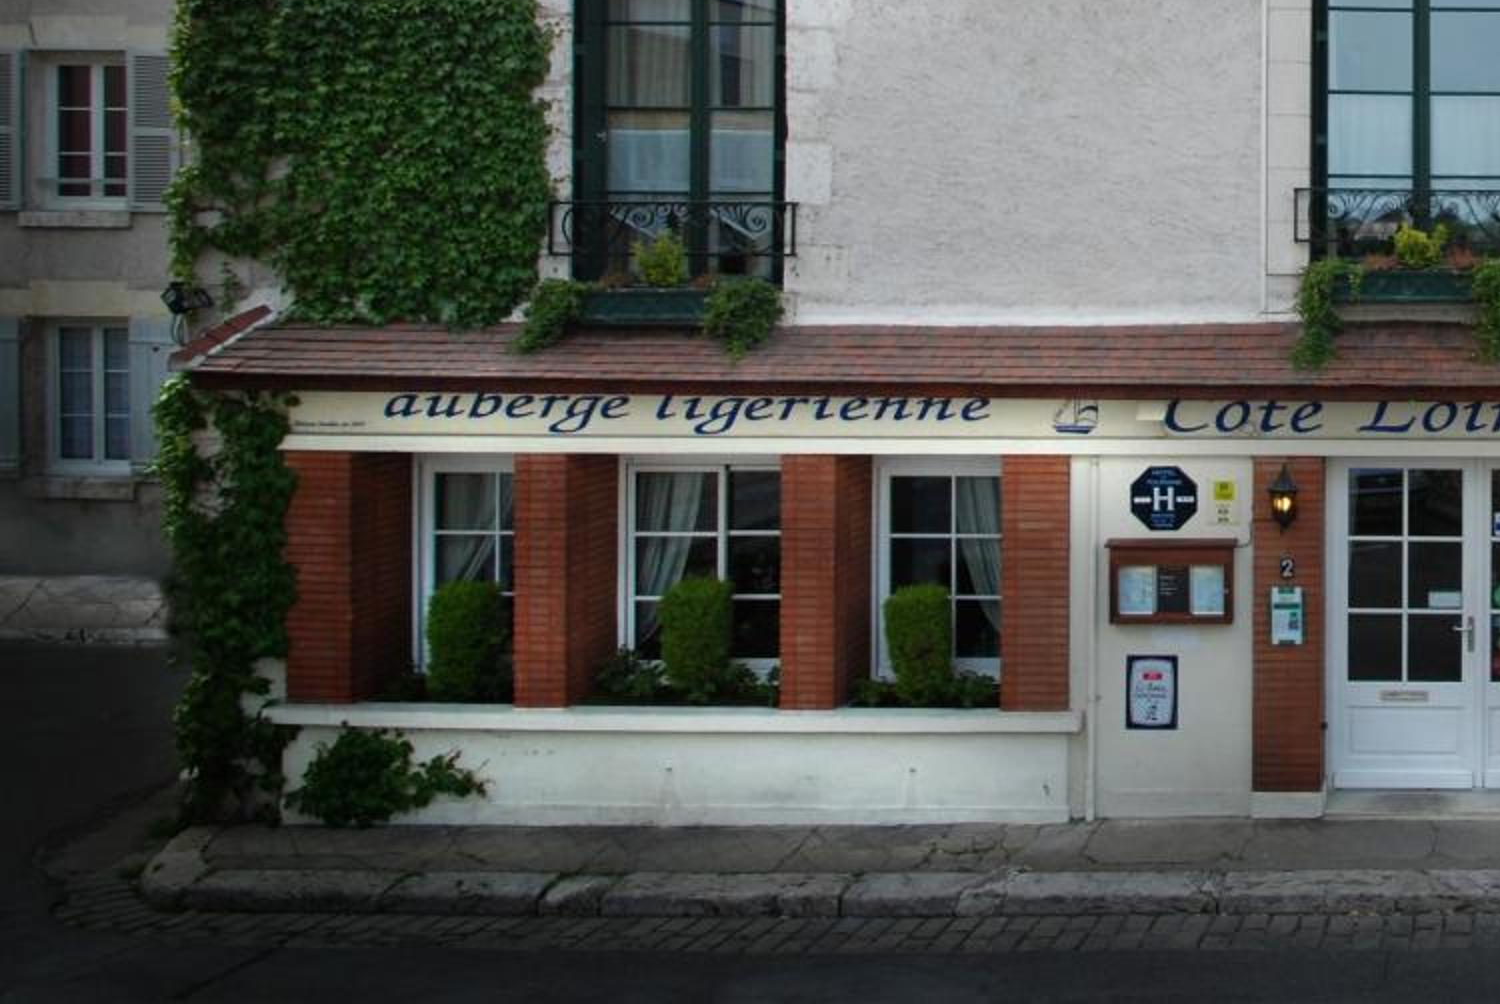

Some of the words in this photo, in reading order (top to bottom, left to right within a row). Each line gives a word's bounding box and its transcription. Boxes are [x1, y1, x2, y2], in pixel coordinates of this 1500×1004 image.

[383, 391, 630, 433] auberge
[1153, 487, 1175, 511] H
[1280, 558, 1294, 577] 2
